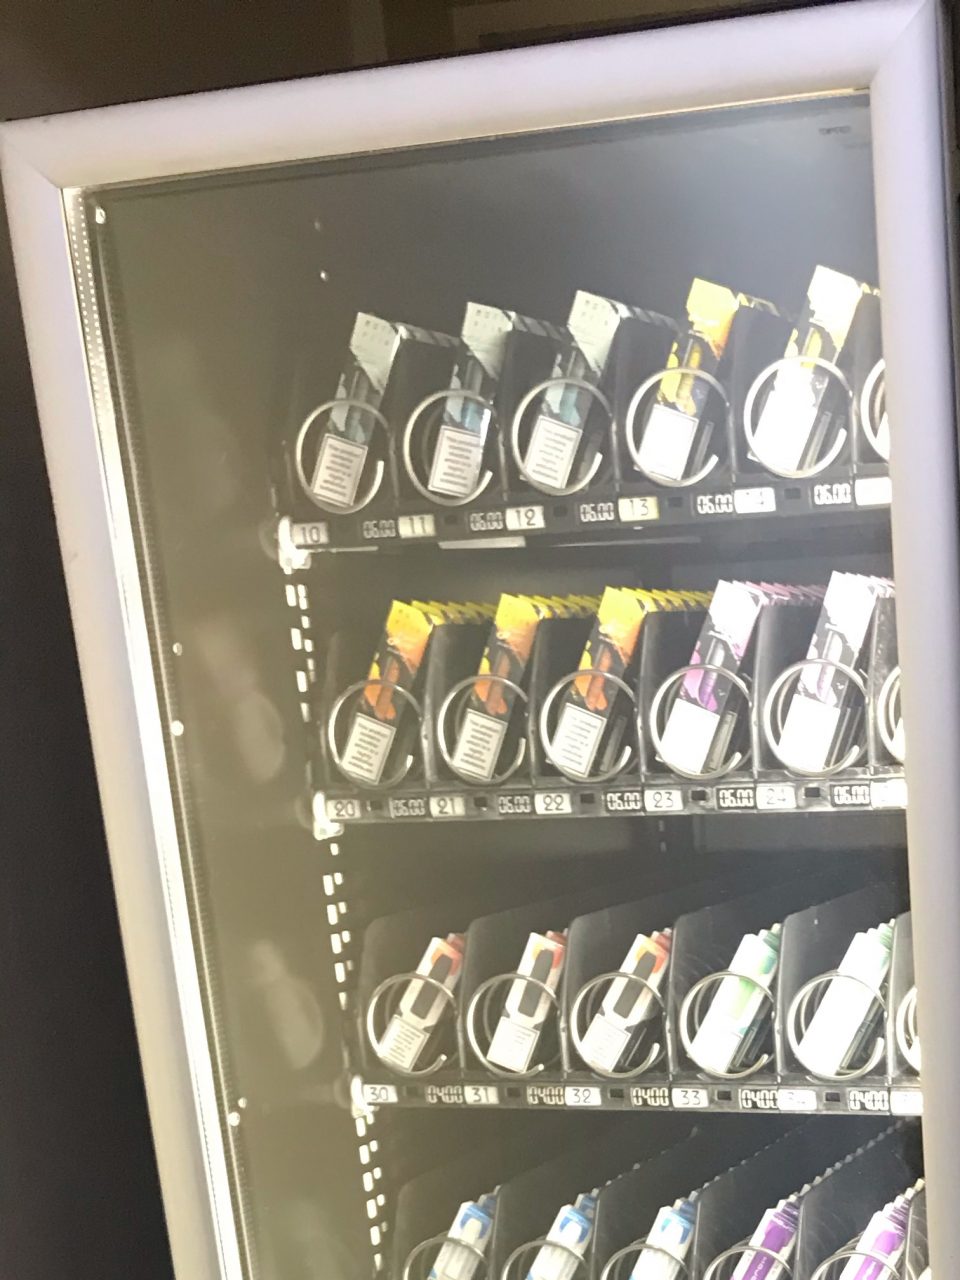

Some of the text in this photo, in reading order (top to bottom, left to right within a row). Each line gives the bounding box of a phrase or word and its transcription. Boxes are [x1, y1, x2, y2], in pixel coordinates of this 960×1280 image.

[628, 498, 649, 516] 13
[409, 516, 426, 534] 11
[515, 508, 536, 527] 12
[302, 526, 320, 543] 10
[438, 798, 456, 815] 21
[543, 794, 564, 811] 22
[653, 791, 674, 808] 23
[334, 802, 356, 817] 20
[369, 1086, 388, 1102] 30
[472, 1086, 490, 1103] 31
[571, 1088, 592, 1104] 32
[680, 1089, 701, 1106] 33
